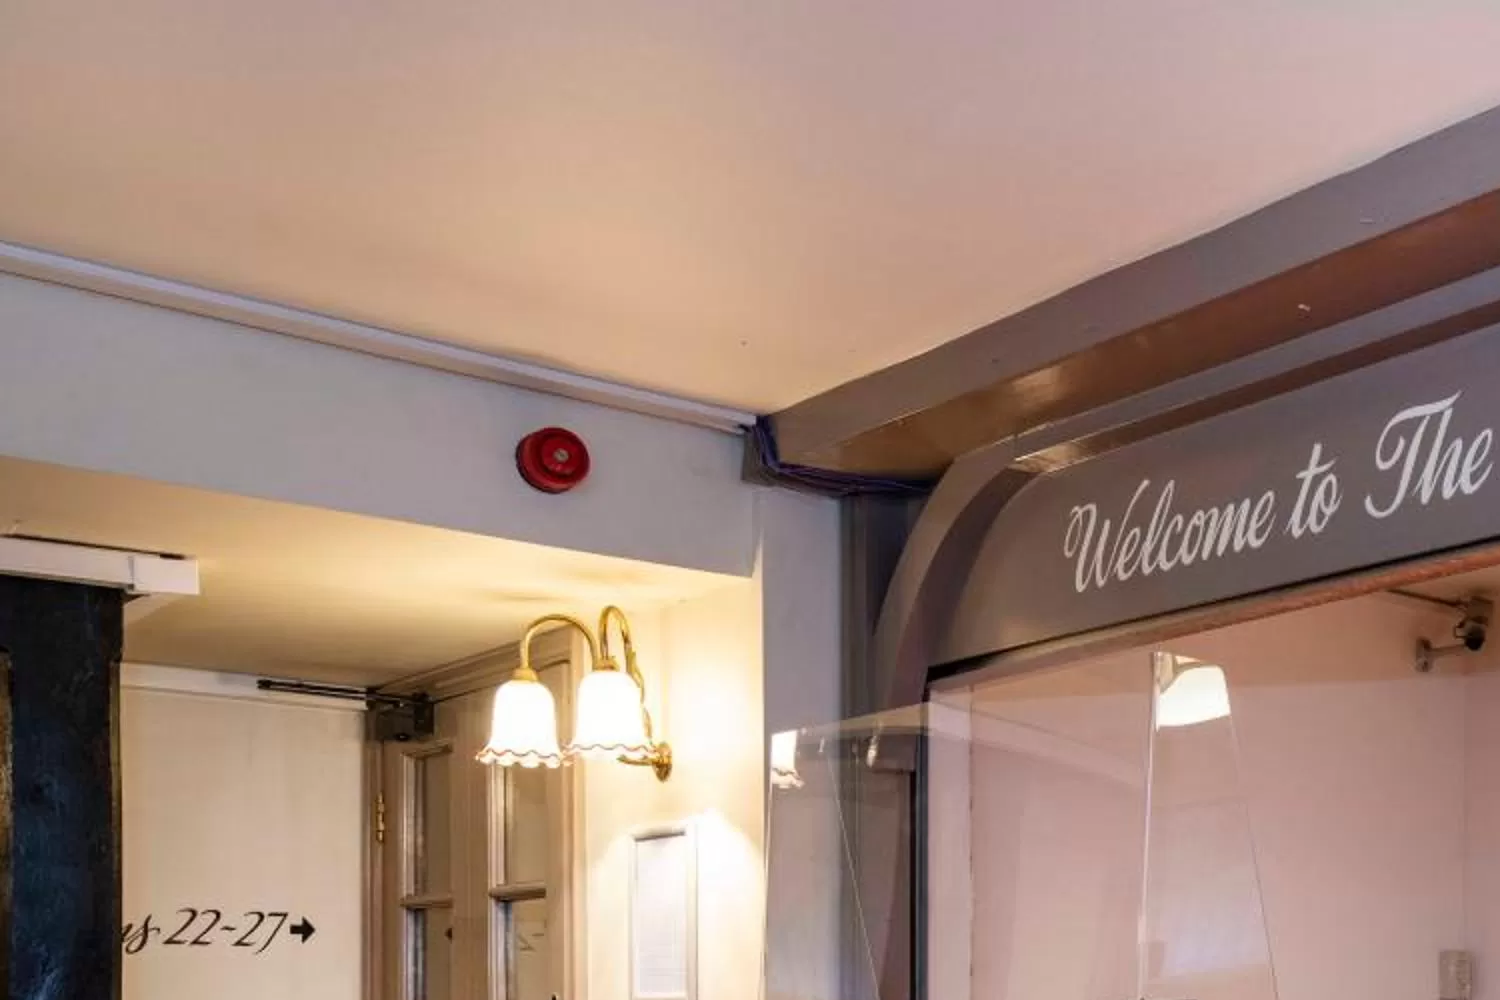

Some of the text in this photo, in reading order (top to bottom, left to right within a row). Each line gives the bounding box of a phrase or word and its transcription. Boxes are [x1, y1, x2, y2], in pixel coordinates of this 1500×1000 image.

[1064, 480, 1276, 592] Welcome
[1286, 443, 1342, 538] to
[1365, 392, 1492, 518] The
